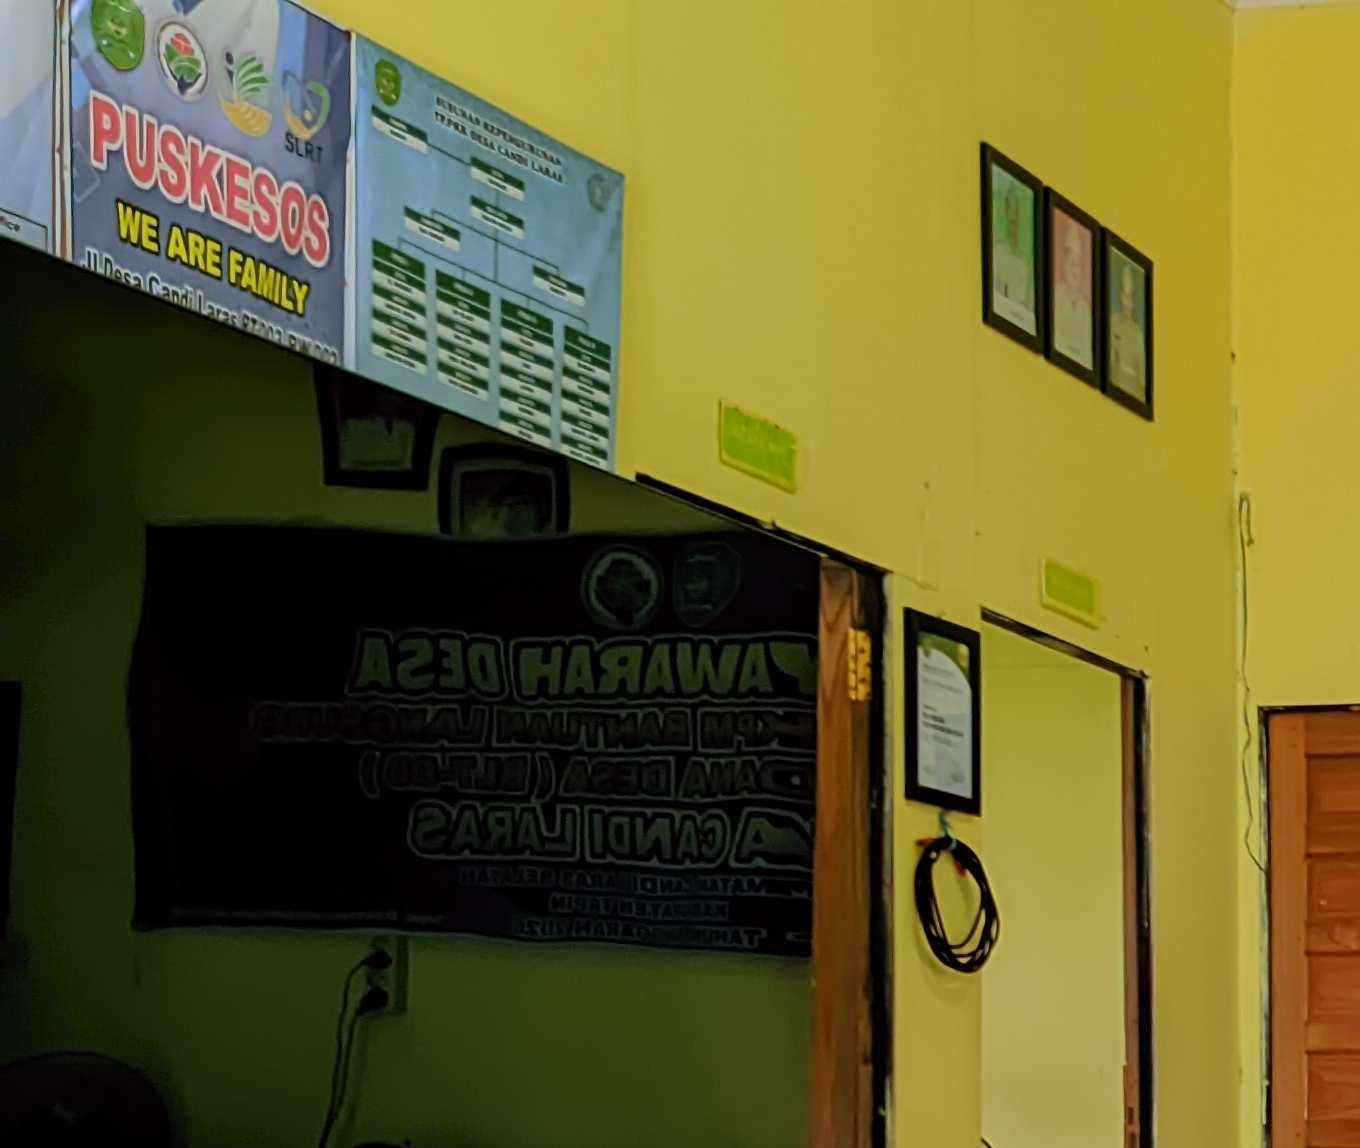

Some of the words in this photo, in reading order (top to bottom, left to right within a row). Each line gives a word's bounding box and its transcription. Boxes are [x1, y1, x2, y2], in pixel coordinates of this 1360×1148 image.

[90, 90, 331, 267] PUSKESOS
[285, 132, 324, 164] SLRT
[116, 199, 160, 255] WE
[166, 224, 223, 280] ARE
[227, 247, 310, 317] FAMILY
